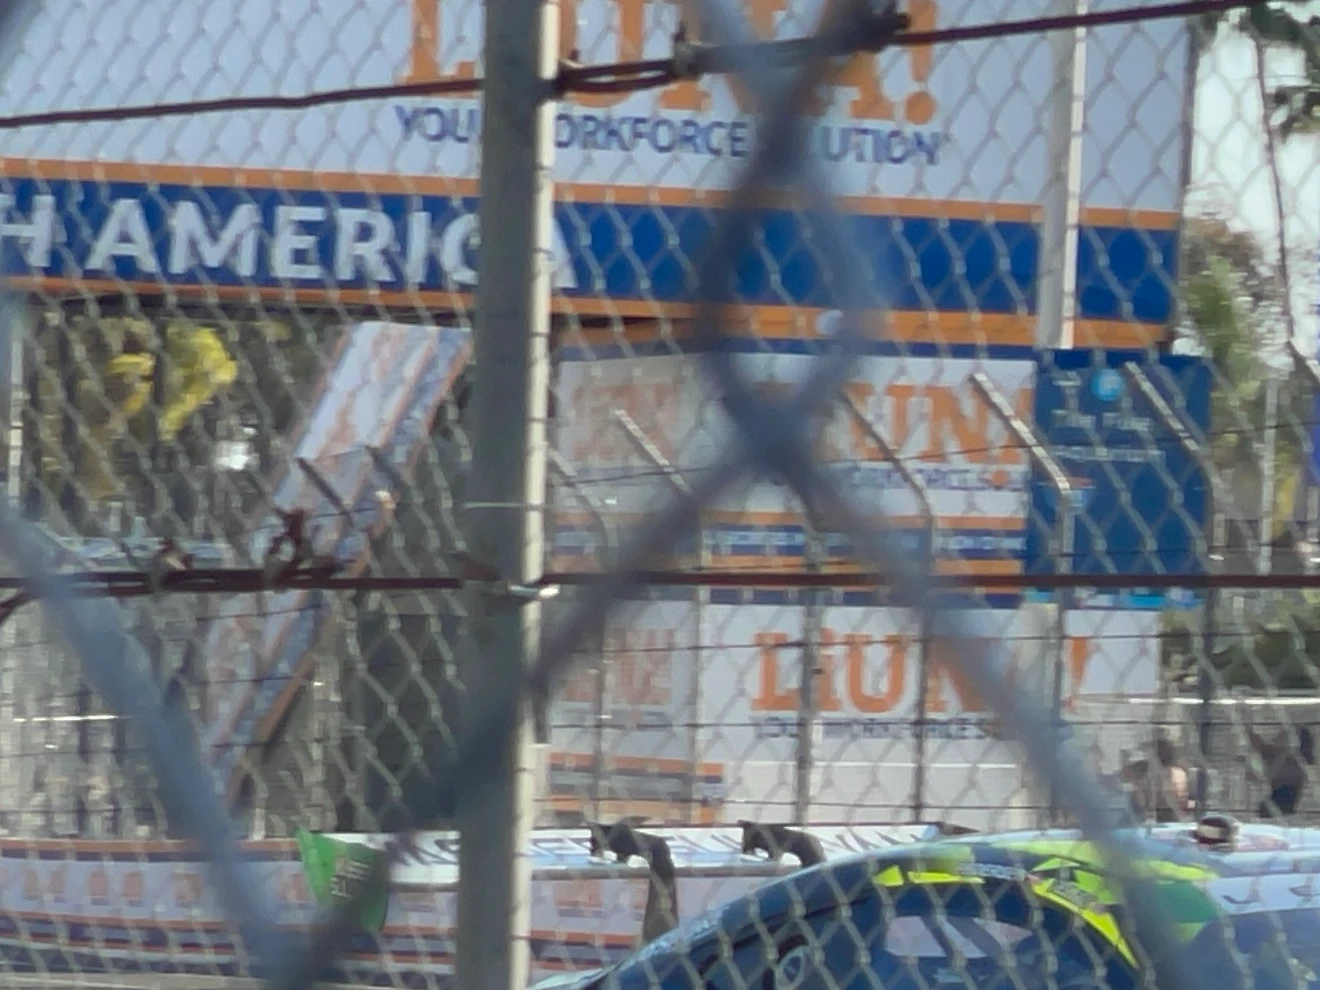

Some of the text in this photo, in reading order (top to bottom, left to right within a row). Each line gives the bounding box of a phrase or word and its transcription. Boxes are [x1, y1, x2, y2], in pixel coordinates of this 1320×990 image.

[394, 104, 942, 165] YOU ORKFORCE UTION
